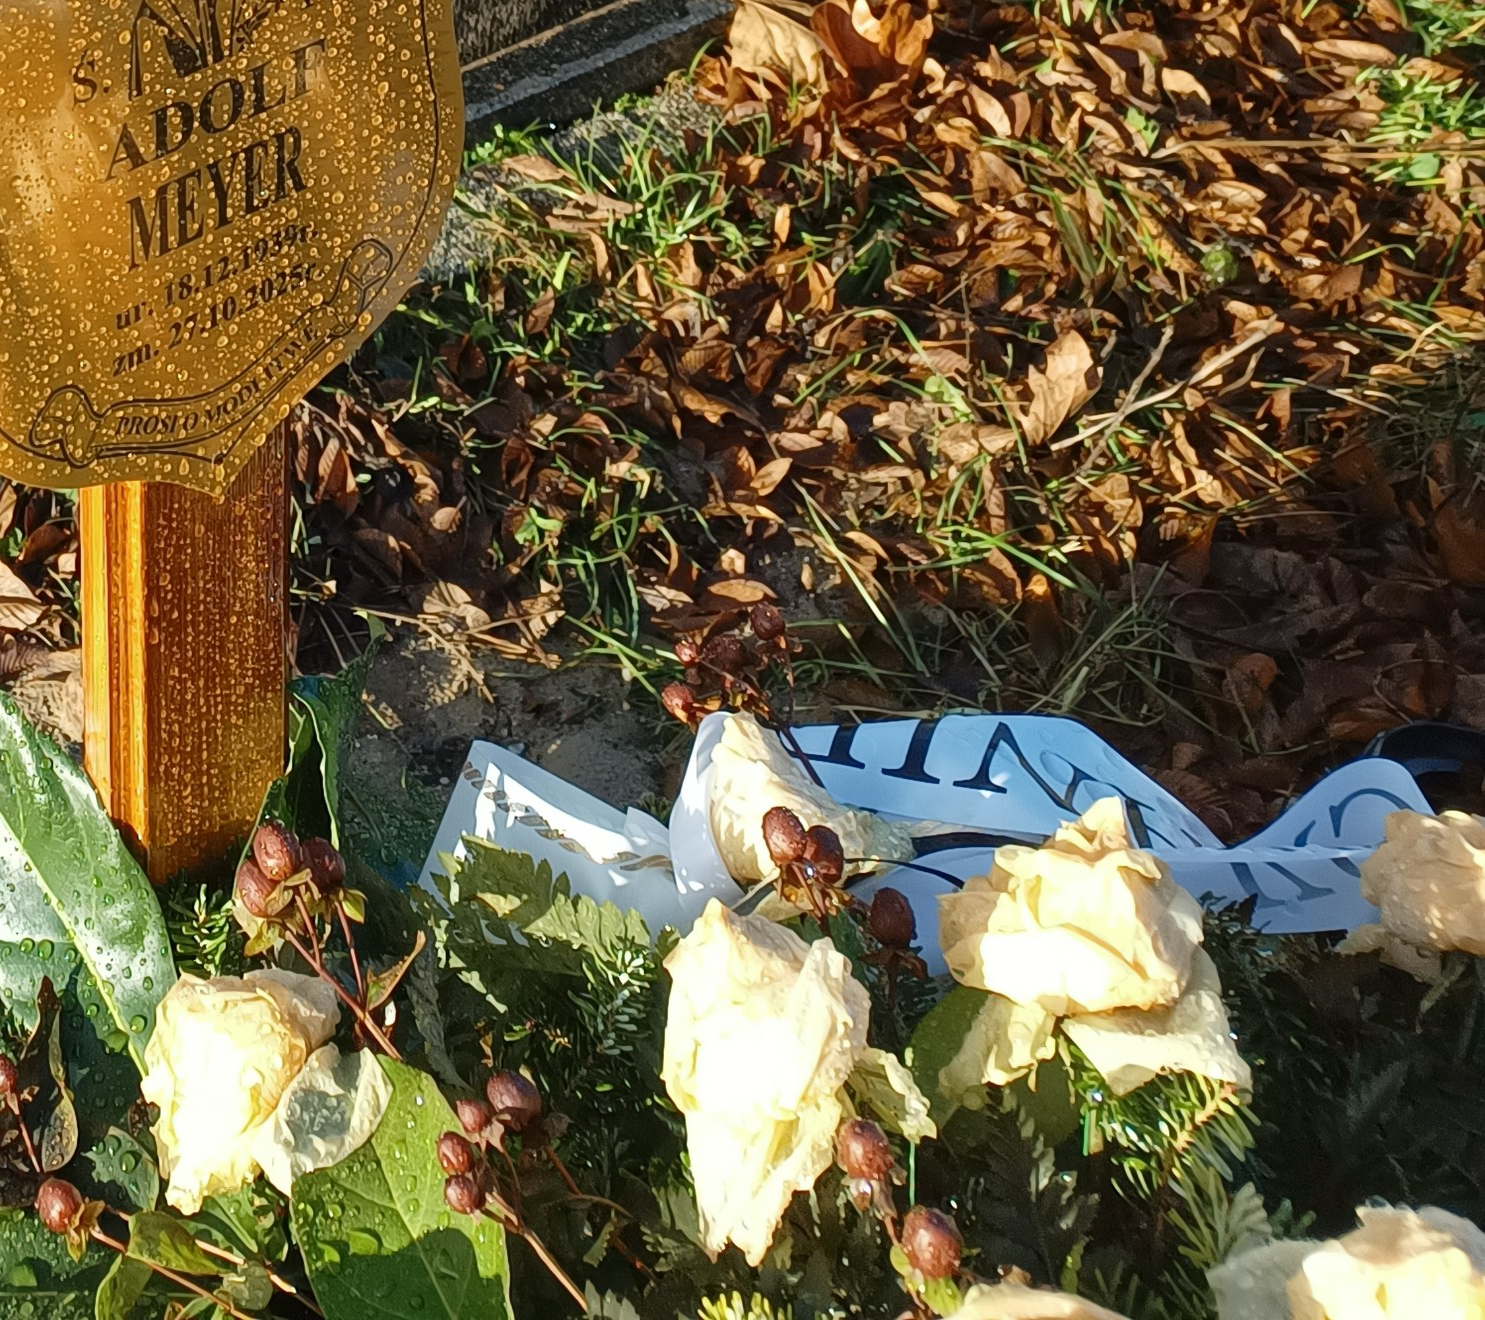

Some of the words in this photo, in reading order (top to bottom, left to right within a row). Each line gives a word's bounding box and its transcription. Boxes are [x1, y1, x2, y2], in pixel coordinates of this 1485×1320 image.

[105, 38, 327, 182] ADOLF
[125, 125, 307, 274] MEYER
[115, 301, 154, 331] ur.
[112, 343, 161, 378] zm.
[115, 414, 179, 437] PROSI
[182, 411, 200, 434] O
